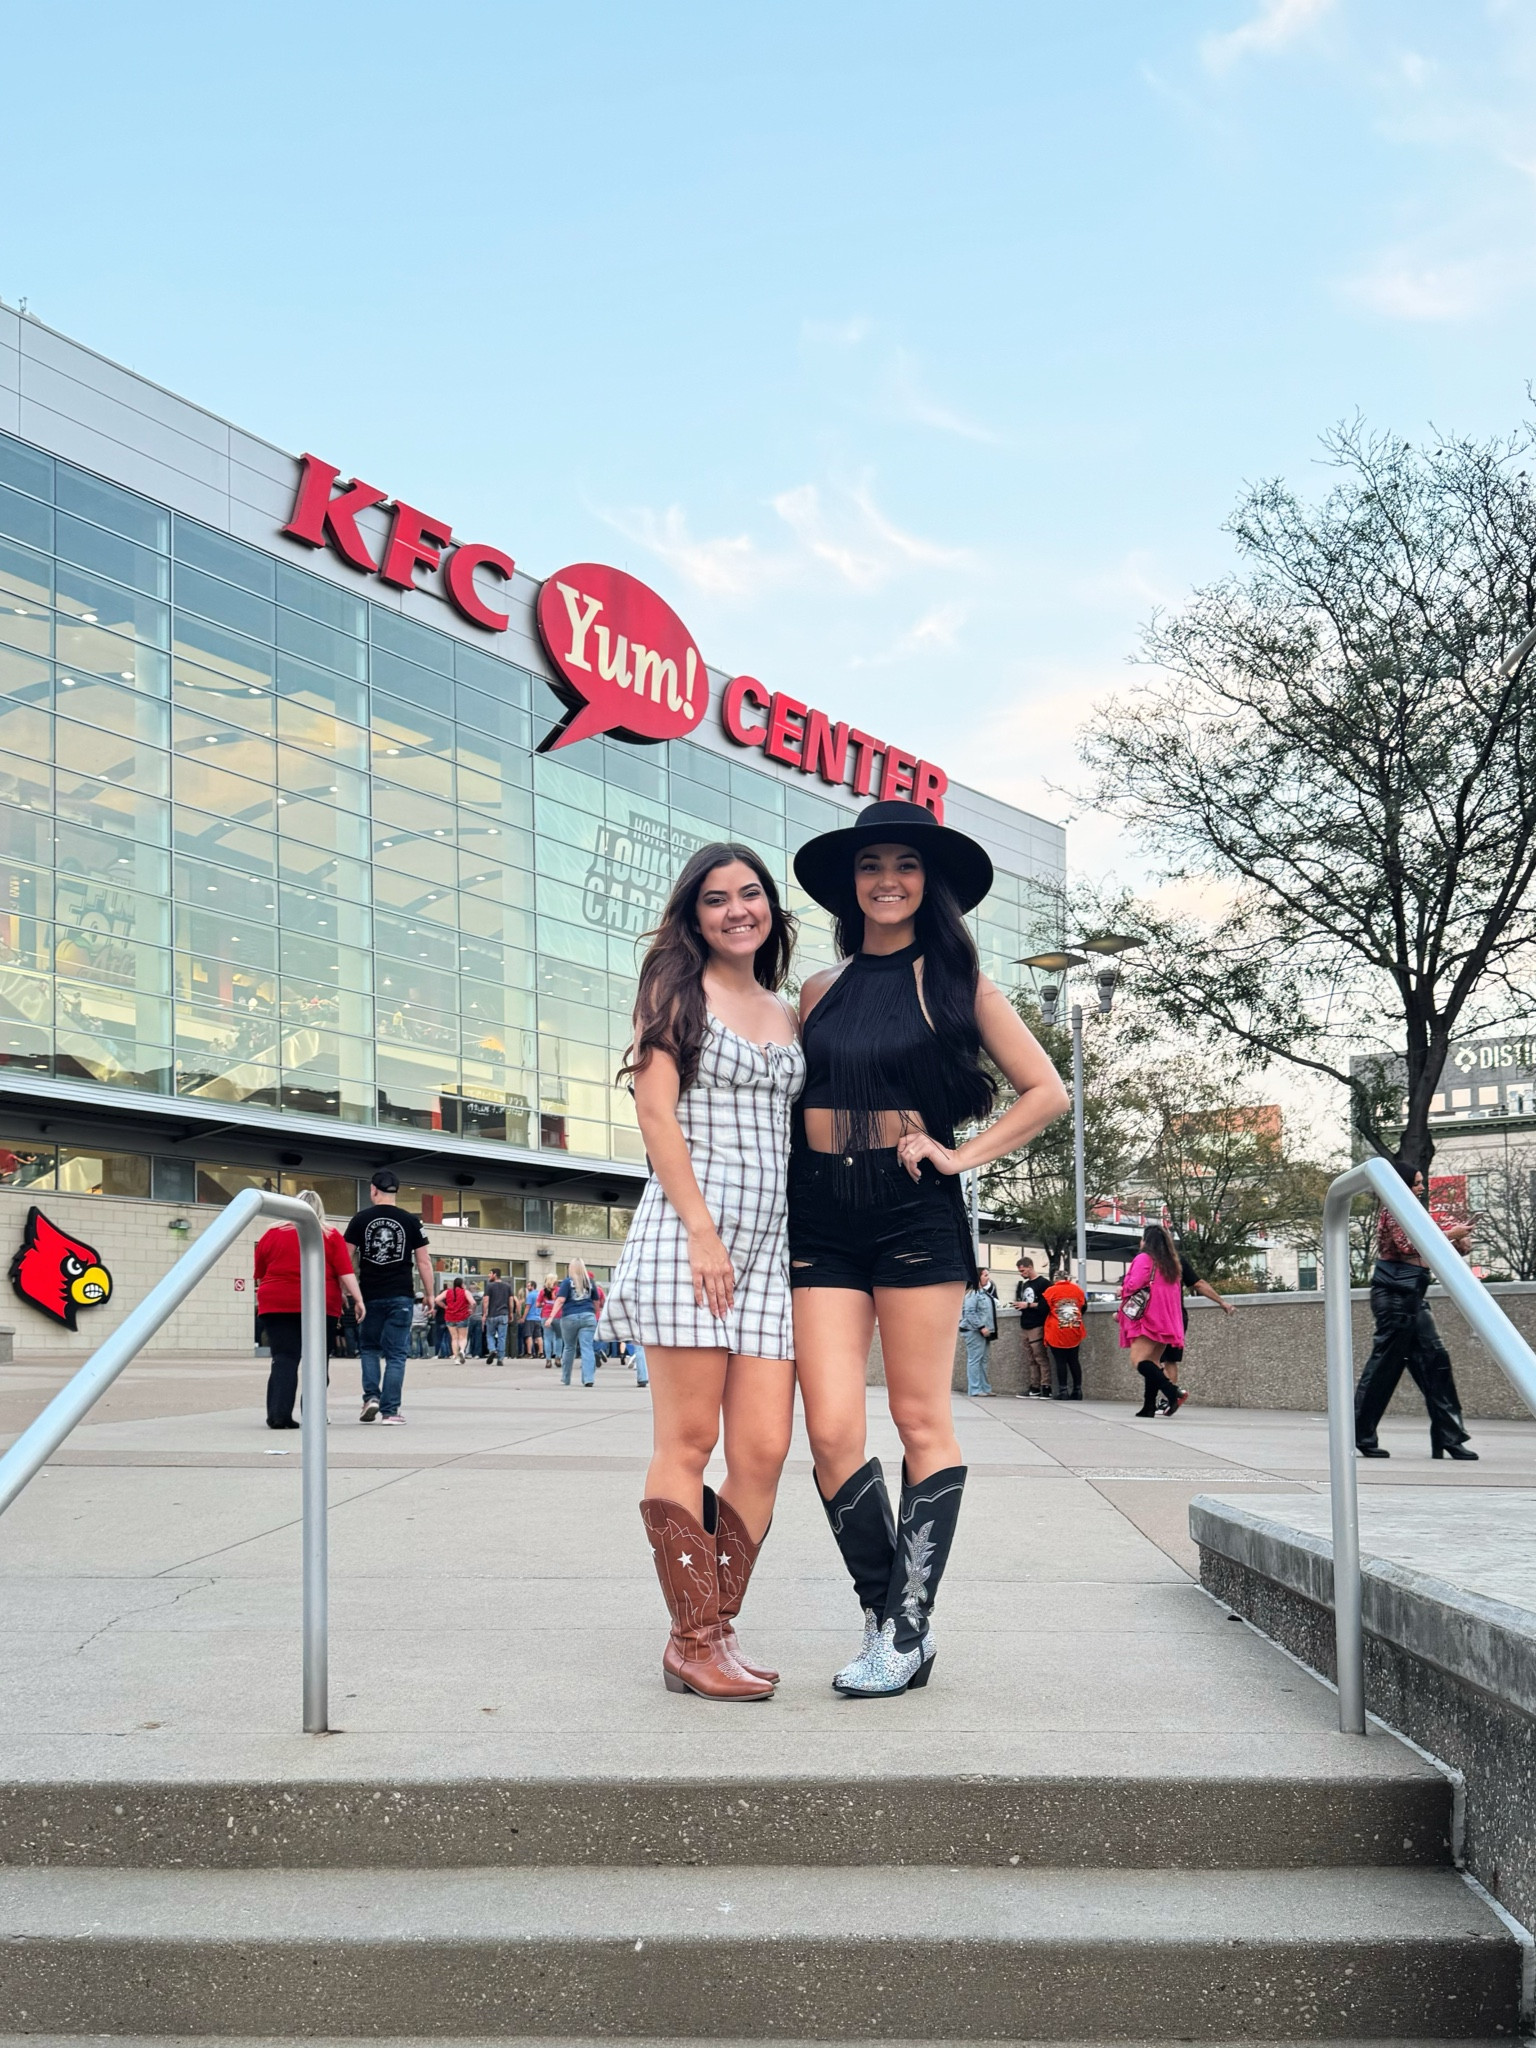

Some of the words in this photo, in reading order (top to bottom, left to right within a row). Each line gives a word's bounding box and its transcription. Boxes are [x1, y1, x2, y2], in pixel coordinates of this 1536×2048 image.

[282, 453, 516, 633] KFC
[556, 581, 698, 720] Yum!
[722, 675, 949, 826] CENTER
[633, 817, 668, 848] HOME
[671, 832, 687, 855] OF
[690, 838, 708, 856] TH
